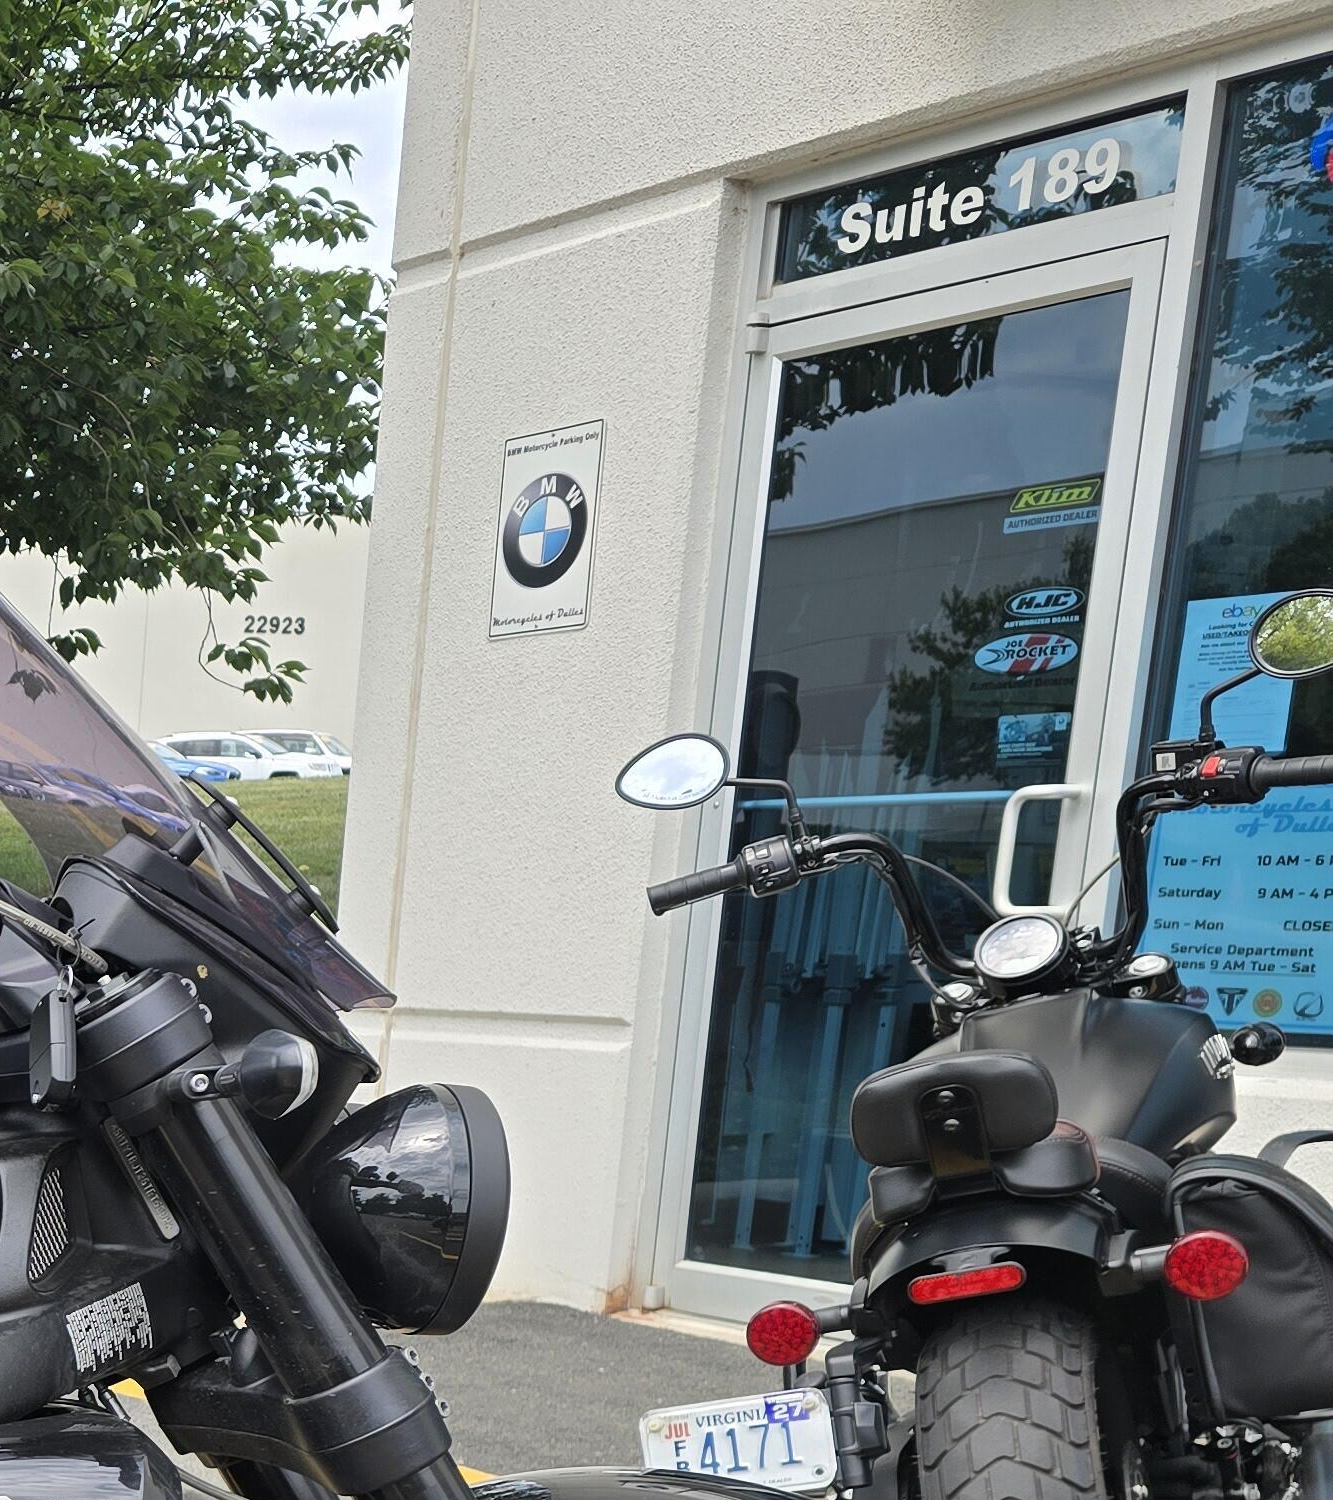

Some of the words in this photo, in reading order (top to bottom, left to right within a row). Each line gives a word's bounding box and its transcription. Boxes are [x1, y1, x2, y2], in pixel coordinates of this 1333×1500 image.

[837, 181, 985, 254] Suite
[1009, 138, 1121, 212] 189
[507, 446, 522, 457] BMW
[524, 440, 558, 454] Motorcycle
[559, 434, 583, 447] Parking
[585, 431, 600, 441] Only
[513, 475, 583, 517] BMW
[1008, 514, 1061, 529] AUTHORIZED
[1063, 509, 1098, 521] DEALER
[1016, 592, 1072, 610] HJC
[1223, 603, 1264, 618] ebay
[244, 614, 306, 636] 22923
[493, 613, 543, 627] Motorcycles
[545, 612, 556, 622] of
[1004, 617, 1051, 629] AUTHORIZED
[1052, 615, 1080, 623] DEALER
[1005, 639, 1023, 649] JOE
[1006, 644, 1072, 660] ROCKET
[1163, 855, 1187, 867] Tue
[1201, 855, 1221, 867] Fri
[1257, 854, 1272, 867] 10
[1275, 854, 1299, 867] AM
[1315, 855, 1325, 867] 6
[1158, 886, 1222, 900] Saturday
[1257, 887, 1267, 899] 9
[1270, 887, 1294, 900] AM
[1309, 887, 1319, 899] 4
[1153, 918, 1180, 931] Sun
[1194, 919, 1224, 931] Mon
[1170, 942, 1223, 954] Service
[1227, 944, 1314, 957] Department
[1174, 960, 1206, 971] pens
[1210, 959, 1219, 970] 9
[1222, 960, 1246, 972] AM
[1251, 961, 1276, 973] Tue
[1291, 961, 1316, 973] Sat
[773, 1402, 803, 1420] 27
[664, 1421, 691, 1440] JUL
[700, 1421, 803, 1475] 4171
